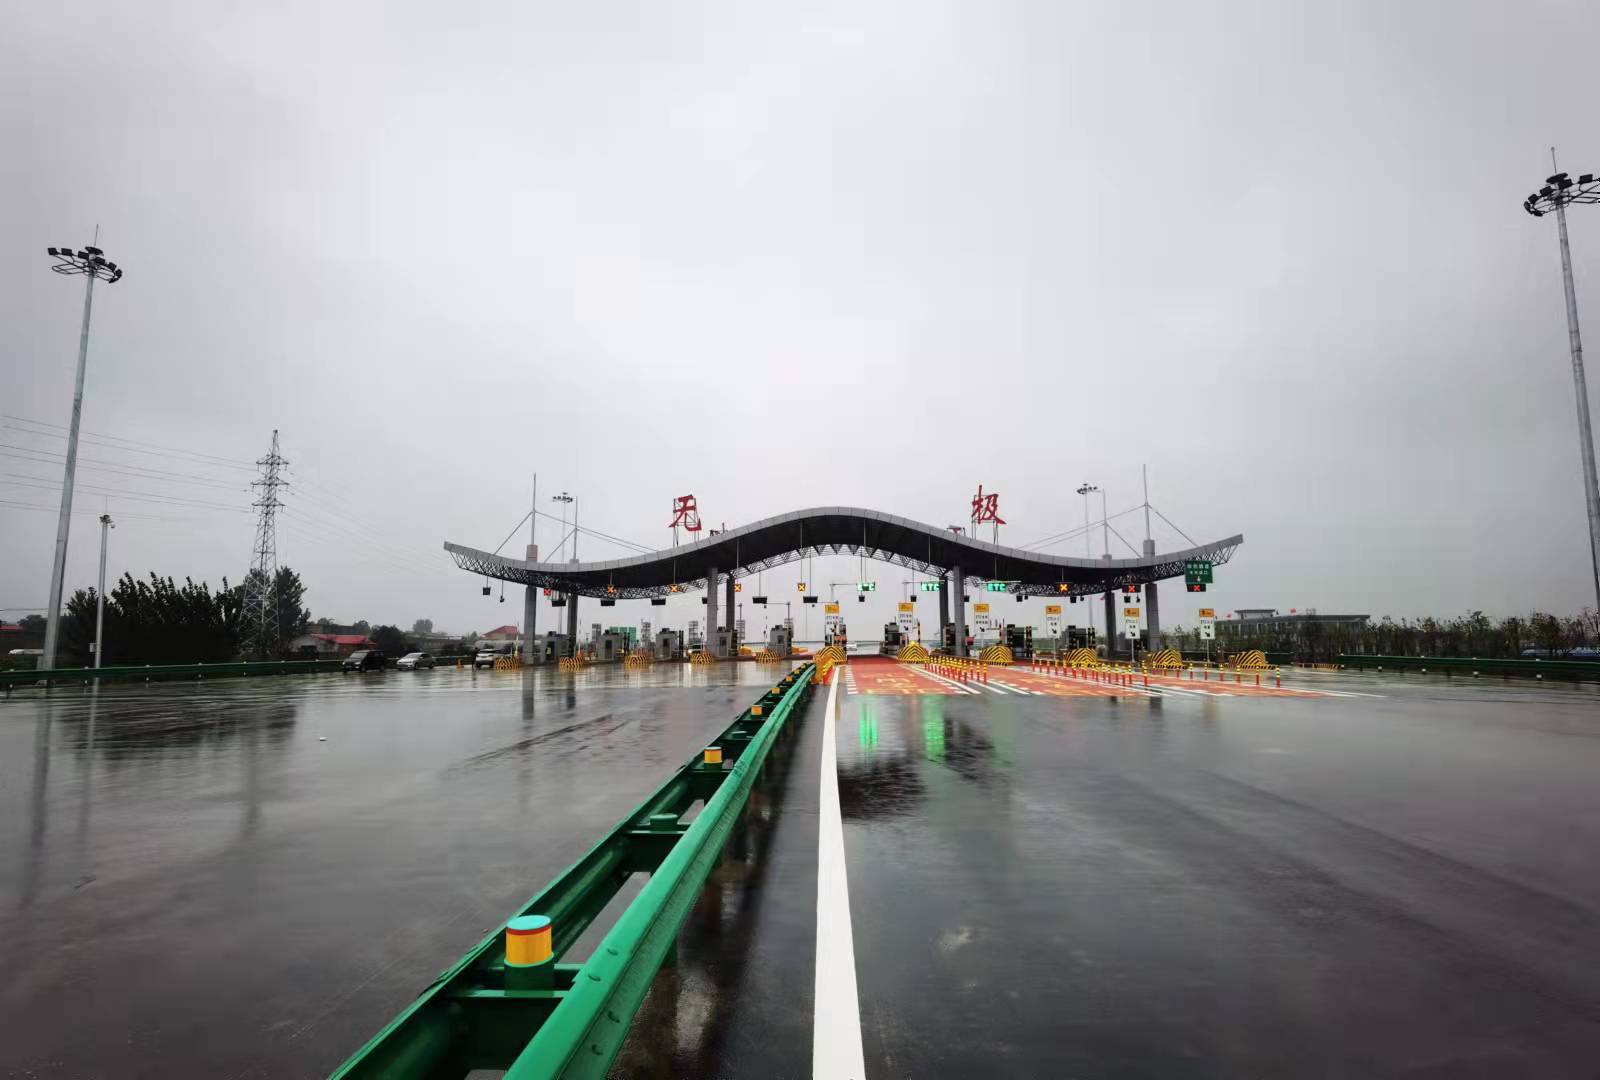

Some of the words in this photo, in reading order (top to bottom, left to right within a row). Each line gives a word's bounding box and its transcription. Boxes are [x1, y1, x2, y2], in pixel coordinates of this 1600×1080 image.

[669, 494, 702, 531] 无
[971, 485, 1006, 524] 极
[921, 583, 940, 591] ETC
[987, 583, 1006, 591] ETC
